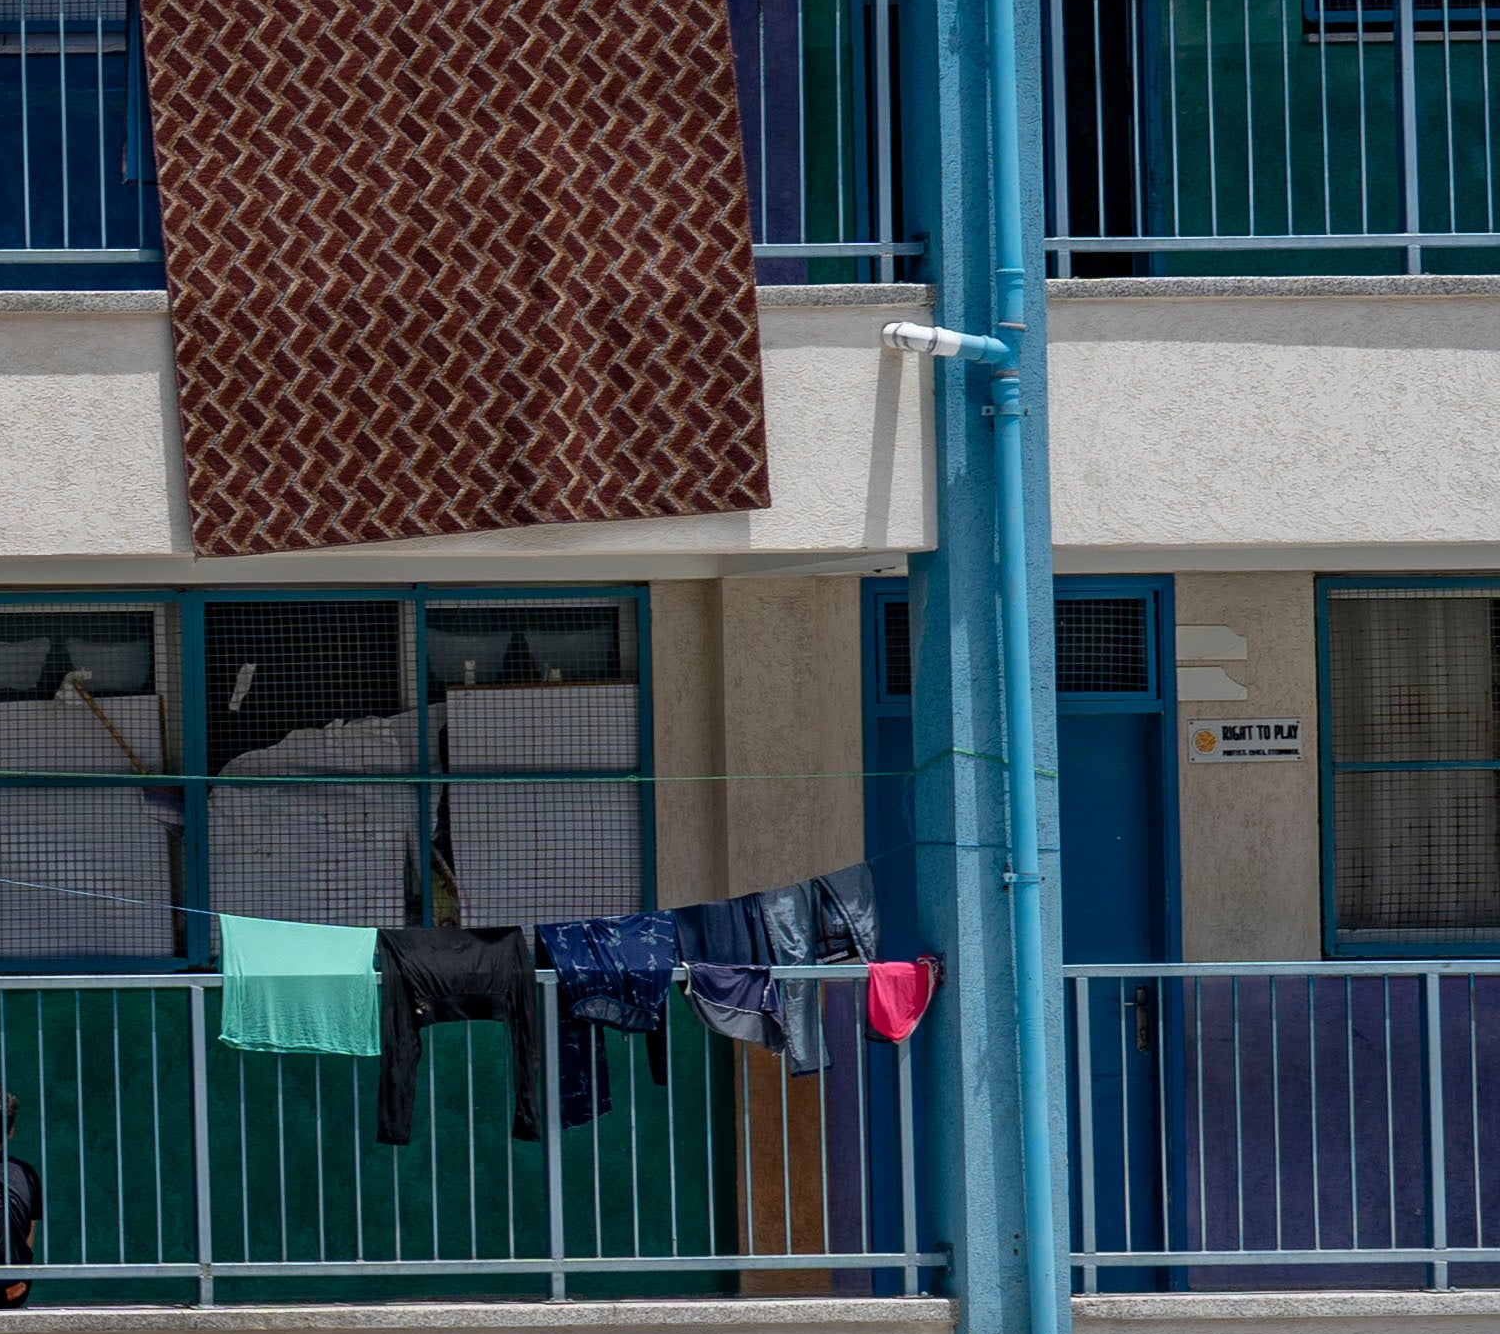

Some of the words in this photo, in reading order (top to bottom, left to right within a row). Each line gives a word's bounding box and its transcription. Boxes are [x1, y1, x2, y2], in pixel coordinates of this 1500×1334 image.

[1222, 725, 1253, 741] RIGHT
[1256, 725, 1270, 740] TO
[1274, 724, 1298, 740] PLAY
